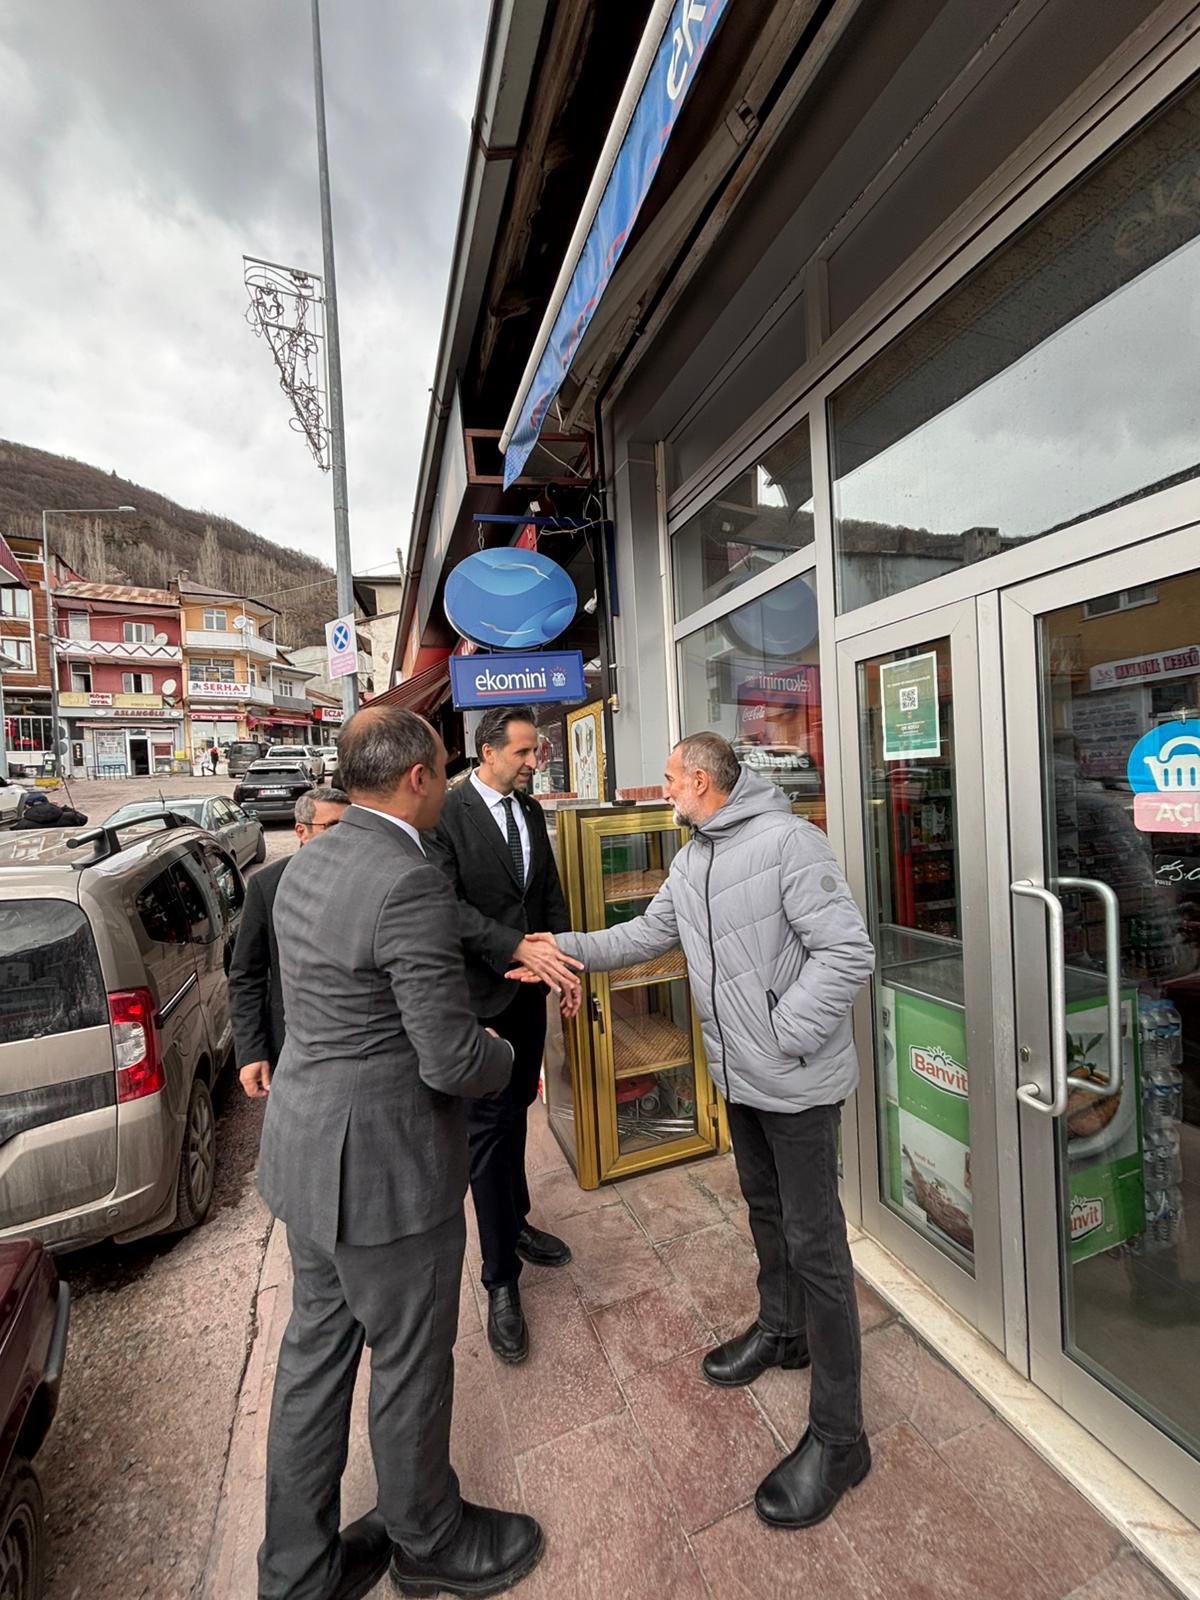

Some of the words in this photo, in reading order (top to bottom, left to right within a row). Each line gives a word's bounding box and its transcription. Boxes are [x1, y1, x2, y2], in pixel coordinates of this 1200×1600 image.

[203, 683, 248, 692] SERHAT
[475, 667, 547, 691] ekomini
[914, 1052, 968, 1093] Banvit
